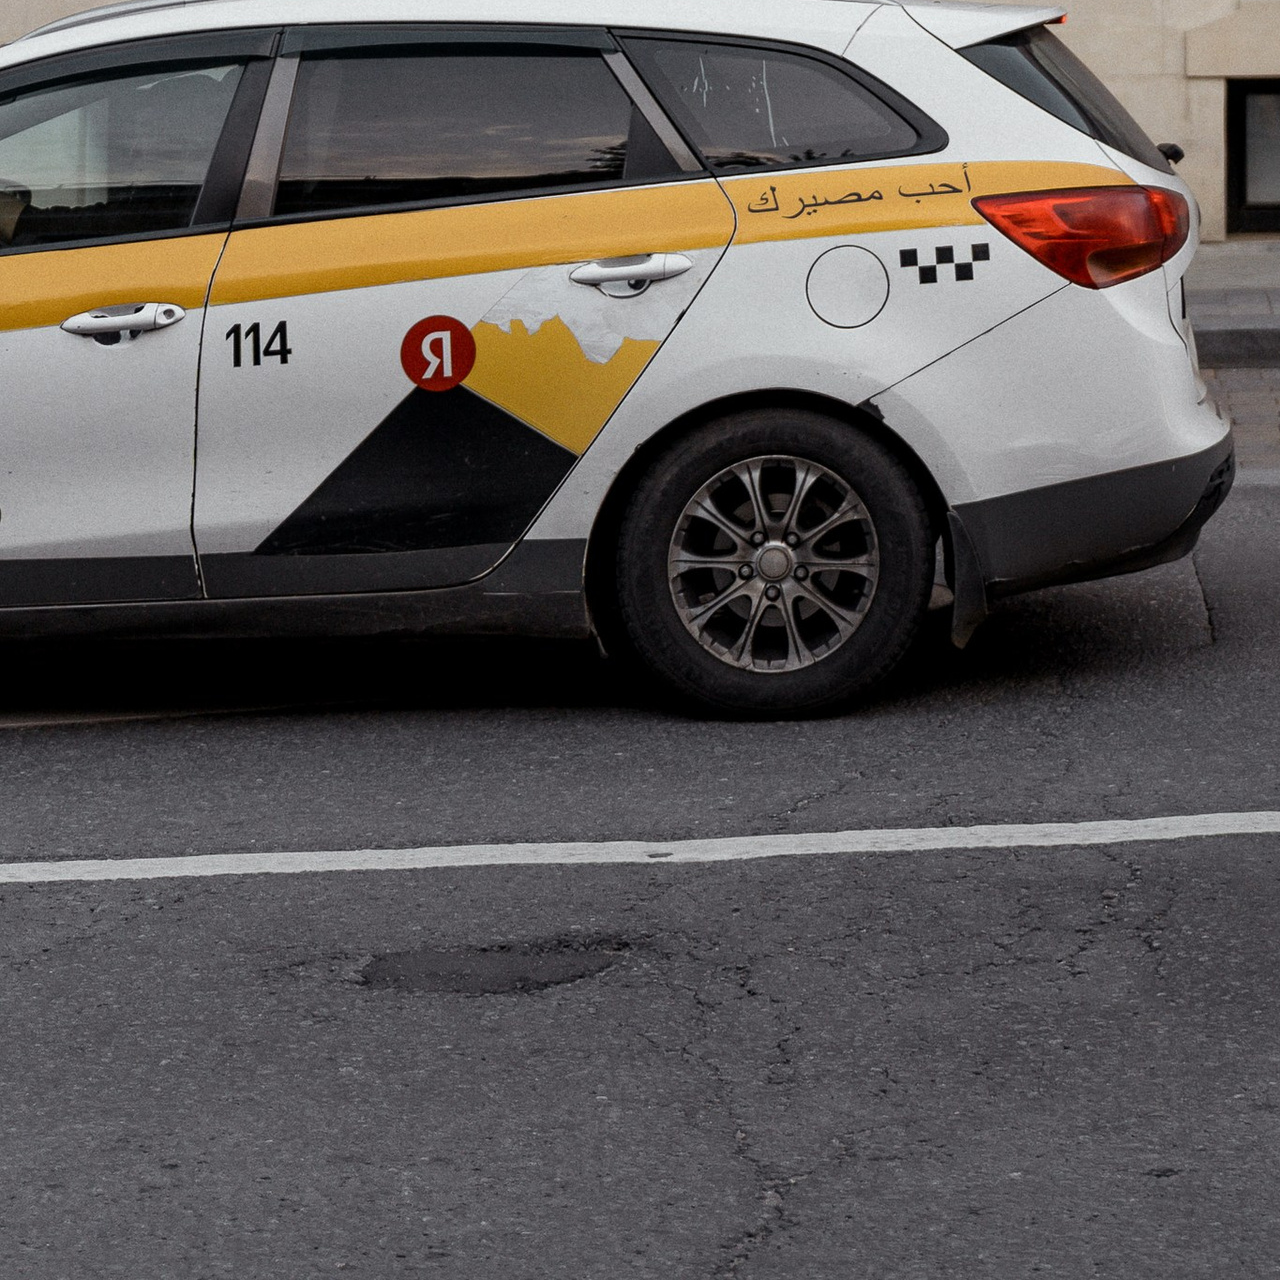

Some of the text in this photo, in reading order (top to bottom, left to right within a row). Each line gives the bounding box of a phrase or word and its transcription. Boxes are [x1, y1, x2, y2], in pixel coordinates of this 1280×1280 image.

[747, 162, 972, 219] أحب مصيرك
[226, 321, 292, 368] 114
[421, 330, 453, 379] Я
